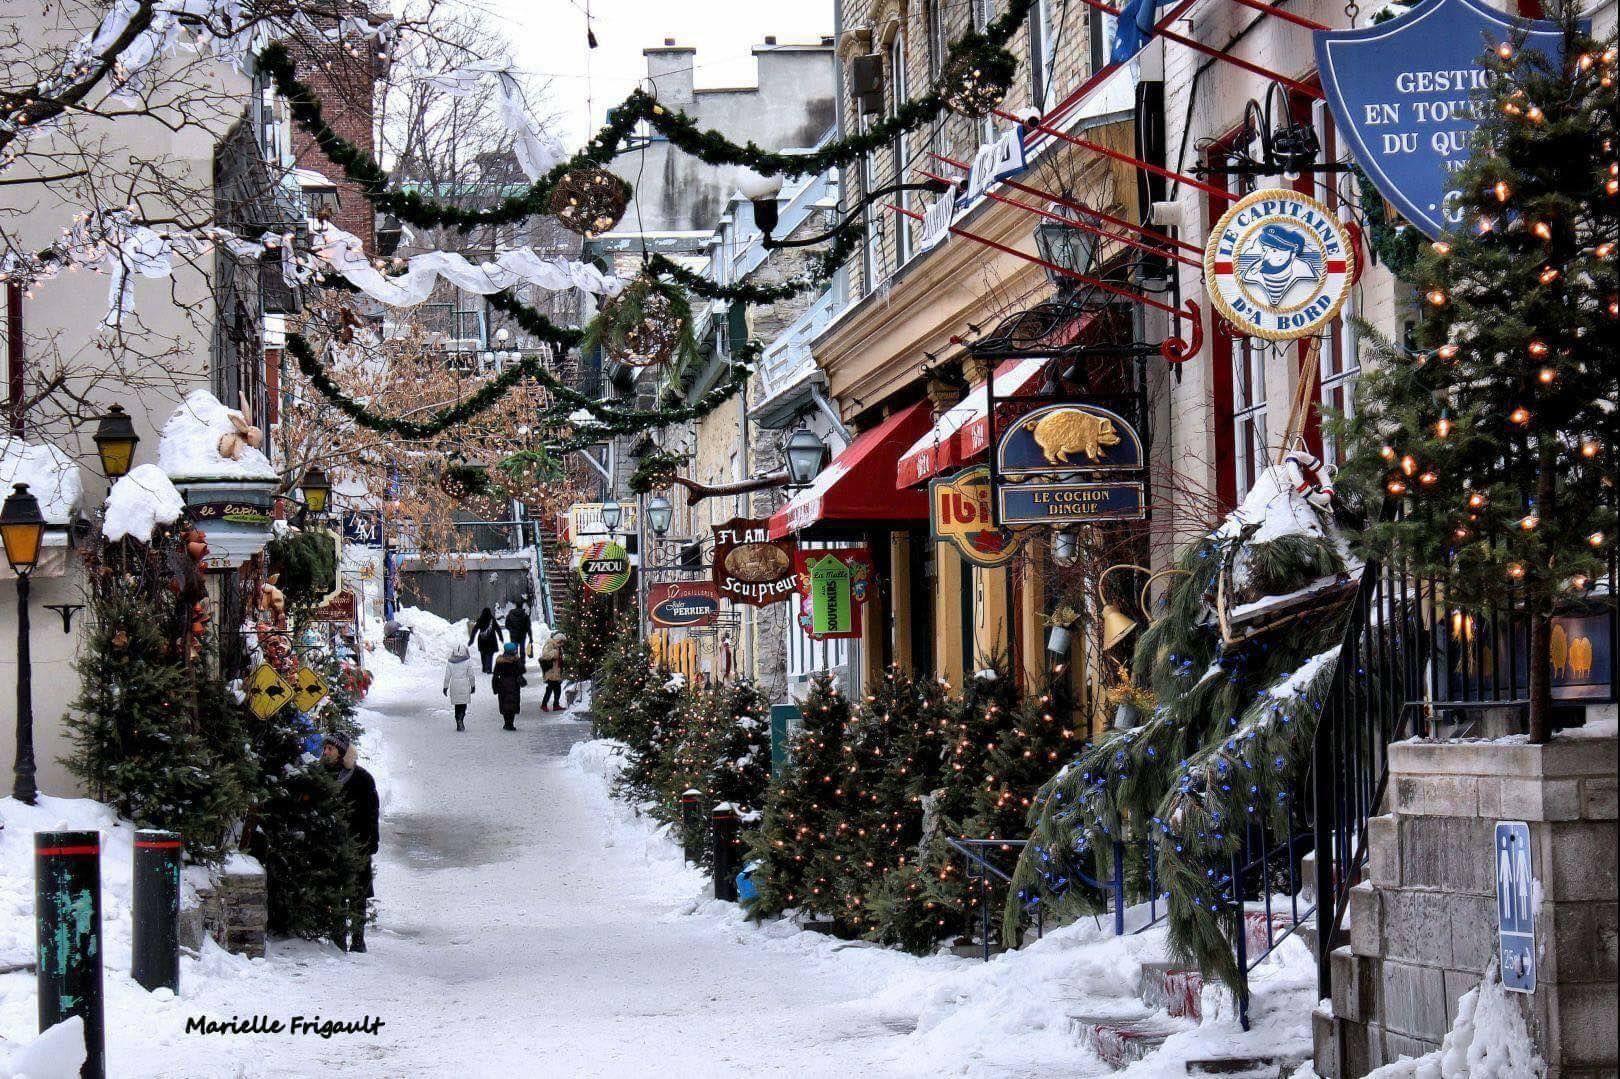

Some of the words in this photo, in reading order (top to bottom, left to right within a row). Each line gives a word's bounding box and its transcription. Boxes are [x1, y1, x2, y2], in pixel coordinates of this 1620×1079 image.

[1396, 69, 1498, 93] GESTIO
[1364, 103, 1401, 125] EN
[1382, 132, 1419, 154] DU
[1219, 228, 1239, 256] LE
[1237, 200, 1340, 256] CAPITAINE
[1277, 294, 1331, 330] BORD
[1033, 491, 1050, 503] LE
[1054, 489, 1110, 502] COCHON
[1048, 503, 1099, 515] DINGUE
[717, 527, 771, 545] FLAM
[588, 560, 623, 573] ZAZOU
[720, 574, 798, 603] Sculpteur
[673, 606, 711, 616] PERRIER
[826, 580, 838, 632] SOUVENIRS
